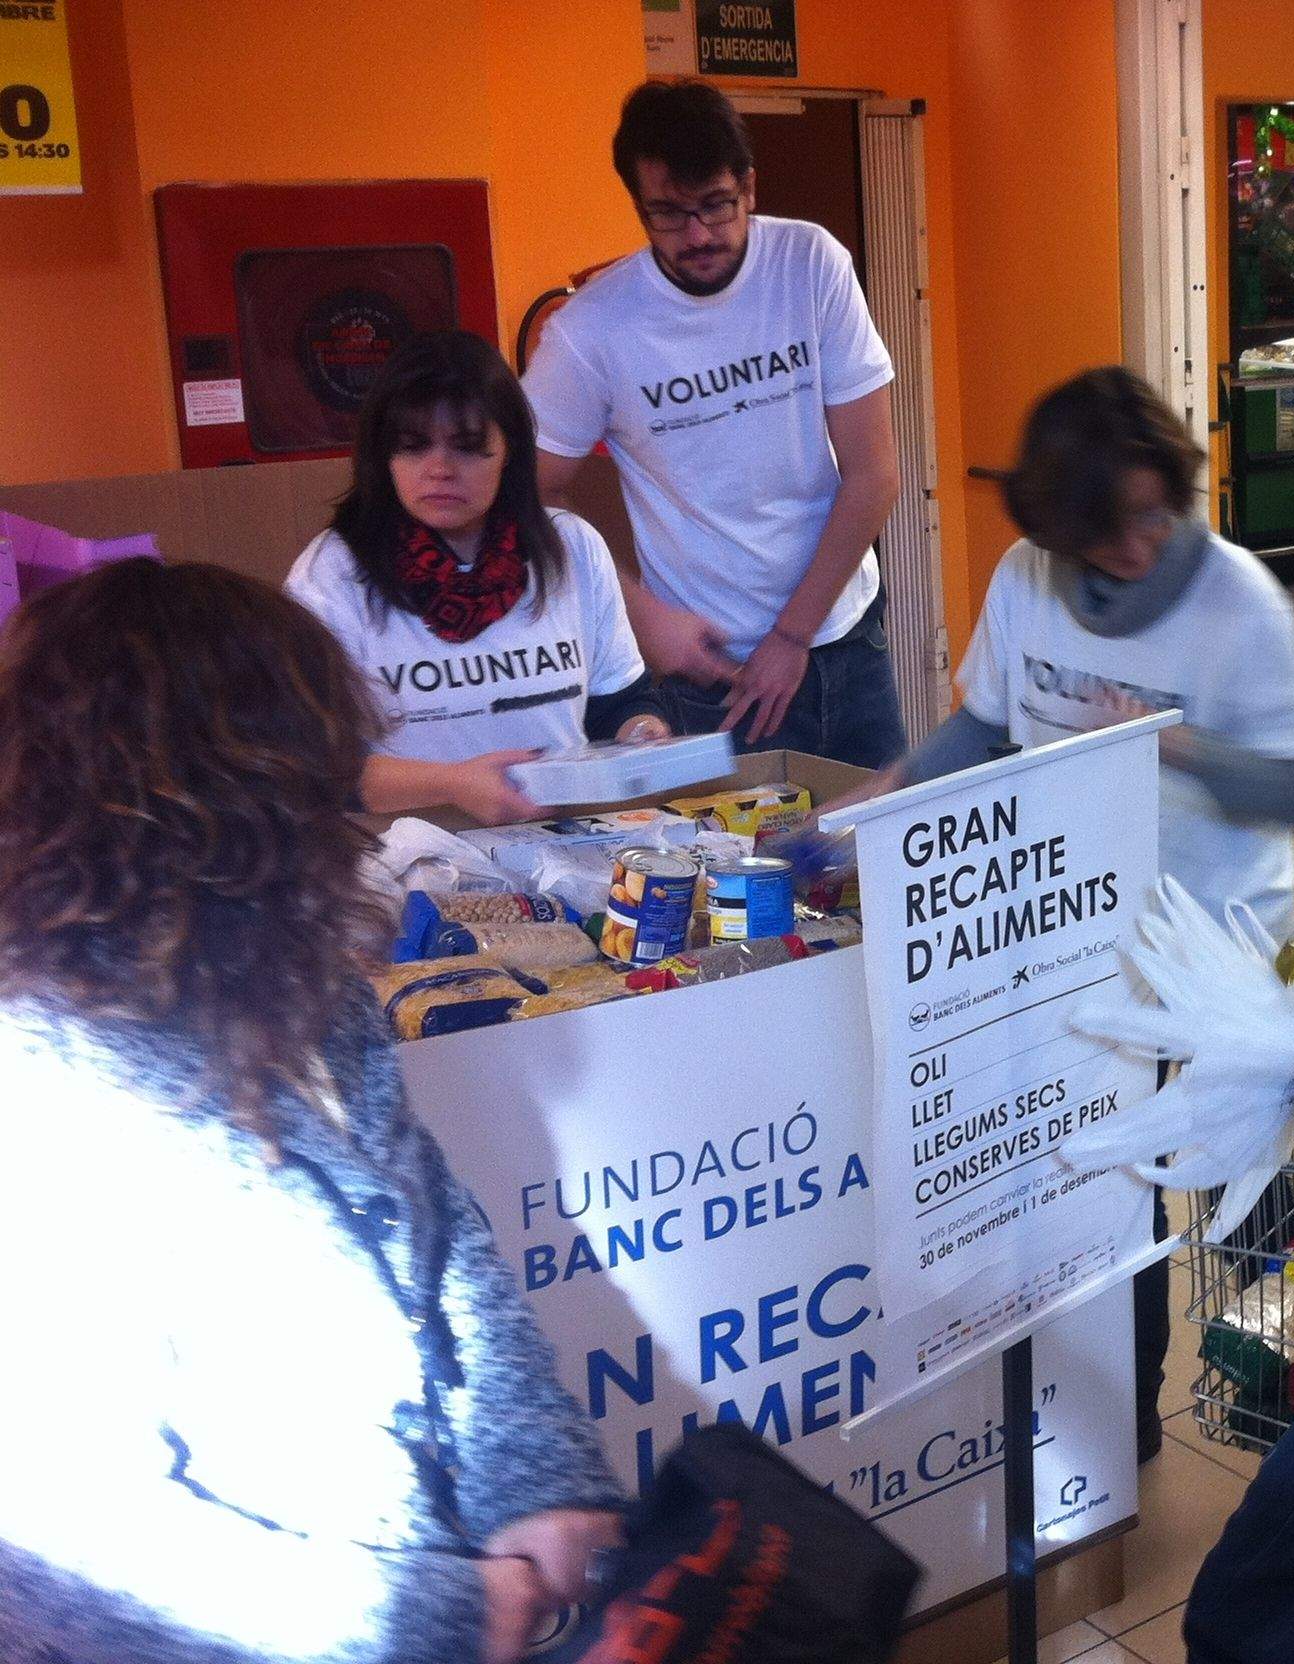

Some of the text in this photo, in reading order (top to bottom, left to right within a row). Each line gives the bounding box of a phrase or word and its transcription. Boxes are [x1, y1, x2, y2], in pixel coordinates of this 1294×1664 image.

[701, 36, 794, 62] D'EMERGENCIA
[719, 4, 773, 29] SORTIDA
[15, 143, 71, 158] 14:30
[640, 341, 810, 409] VOLUNTARI
[379, 639, 582, 694] VOLUNTARI
[903, 796, 1017, 868] GRAN
[906, 835, 1066, 927] RECAPTE
[906, 871, 1118, 983] D'ALIMENTS
[1032, 961, 1055, 977] Obra
[1056, 949, 1082, 967] Social
[933, 985, 1007, 1022] BANC DELS ALIMENTS
[910, 1053, 947, 1088] OLI
[912, 1089, 954, 1128] LLET
[913, 1078, 1066, 1167] LLEGUMS SECS
[521, 1101, 818, 1230] FUNDACIÓ
[916, 1089, 1119, 1204] CONSERVES DE PEIX
[523, 1208, 684, 1292] BANC
[703, 1166, 822, 1241] DELS
[919, 1249, 934, 1270] 30
[937, 1241, 954, 1260] de
[957, 1205, 1020, 1249] novembre
[1041, 1188, 1057, 1205] de
[948, 1205, 988, 1235] podem
[990, 1182, 1031, 1209] canviar
[1033, 1176, 1043, 1189] la
[699, 1263, 884, 1384] REC
